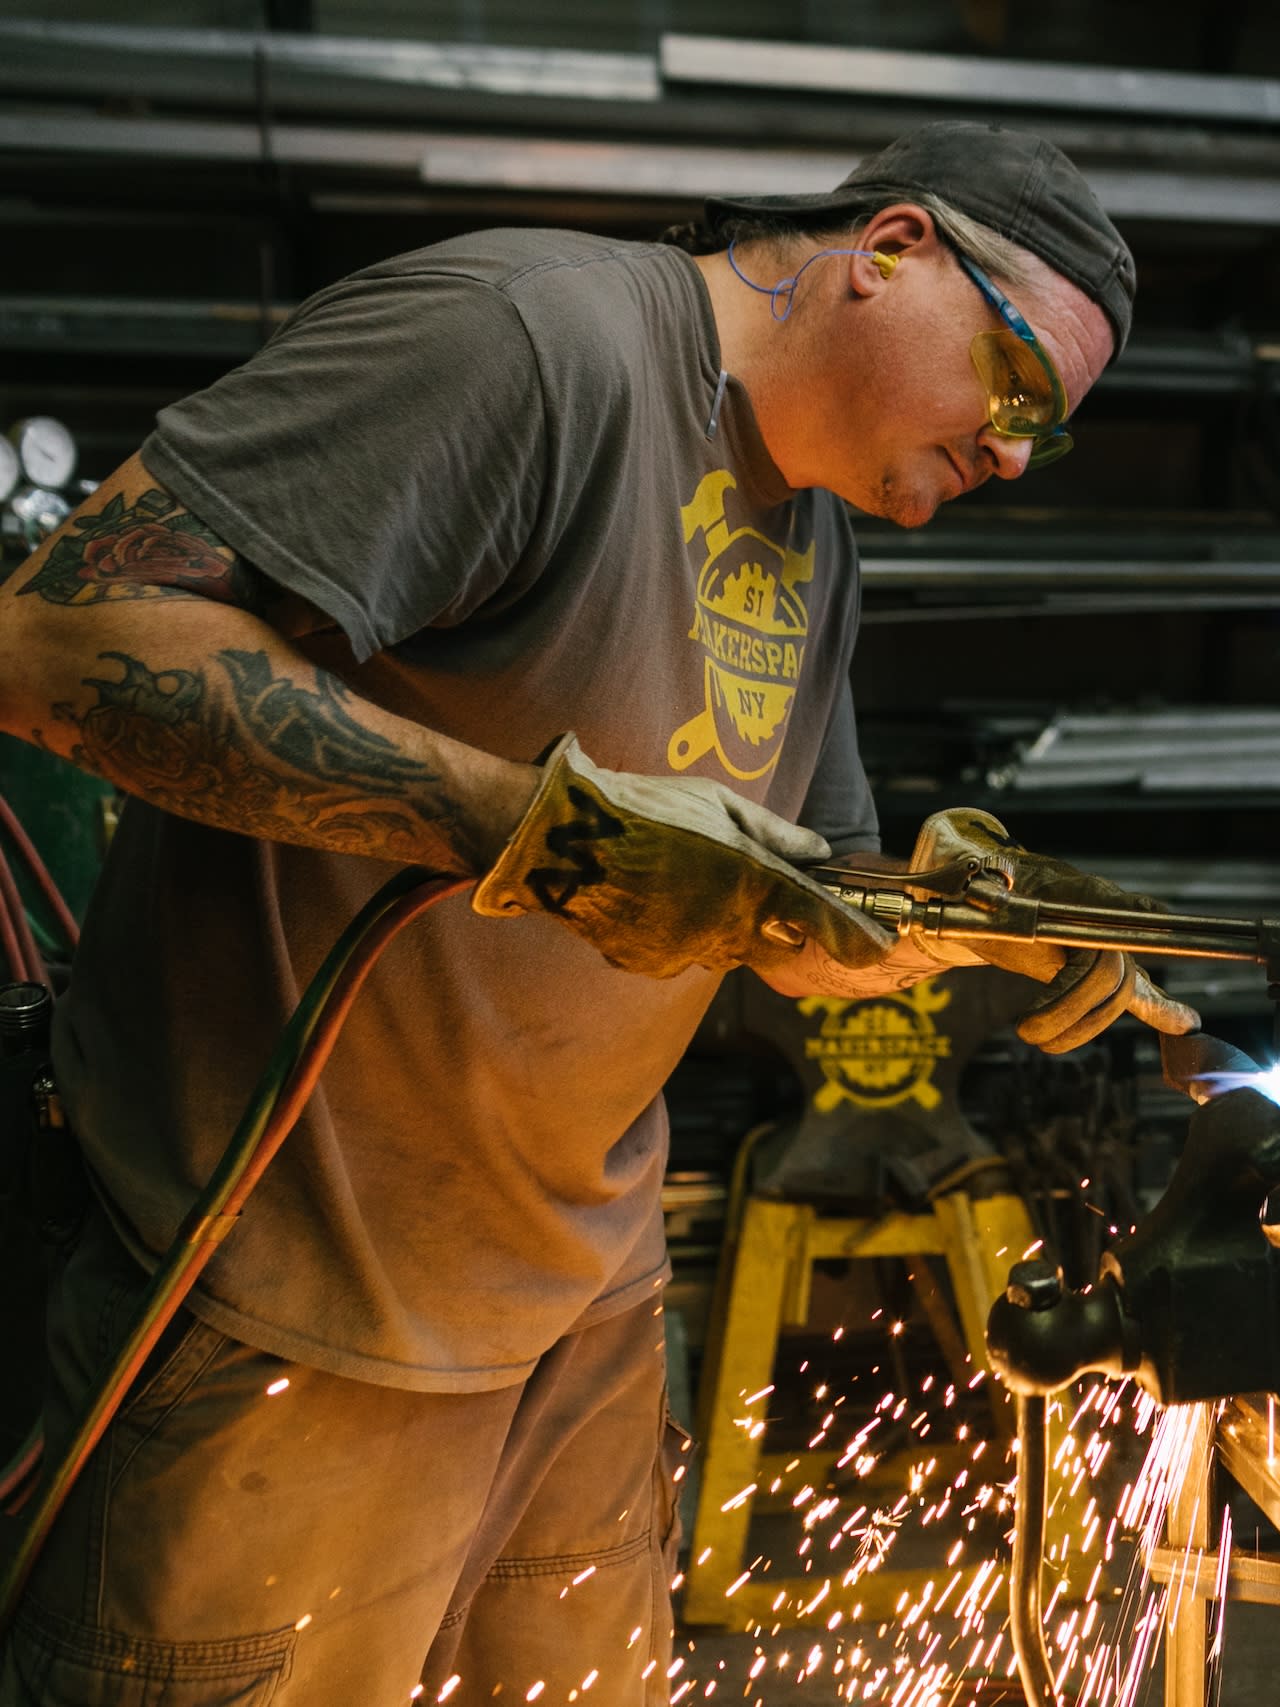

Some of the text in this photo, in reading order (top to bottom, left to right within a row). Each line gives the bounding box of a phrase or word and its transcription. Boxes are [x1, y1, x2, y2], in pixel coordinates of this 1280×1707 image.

[743, 585, 764, 617] SI
[688, 600, 805, 680] MAKERSPA
[738, 688, 766, 719] NY
